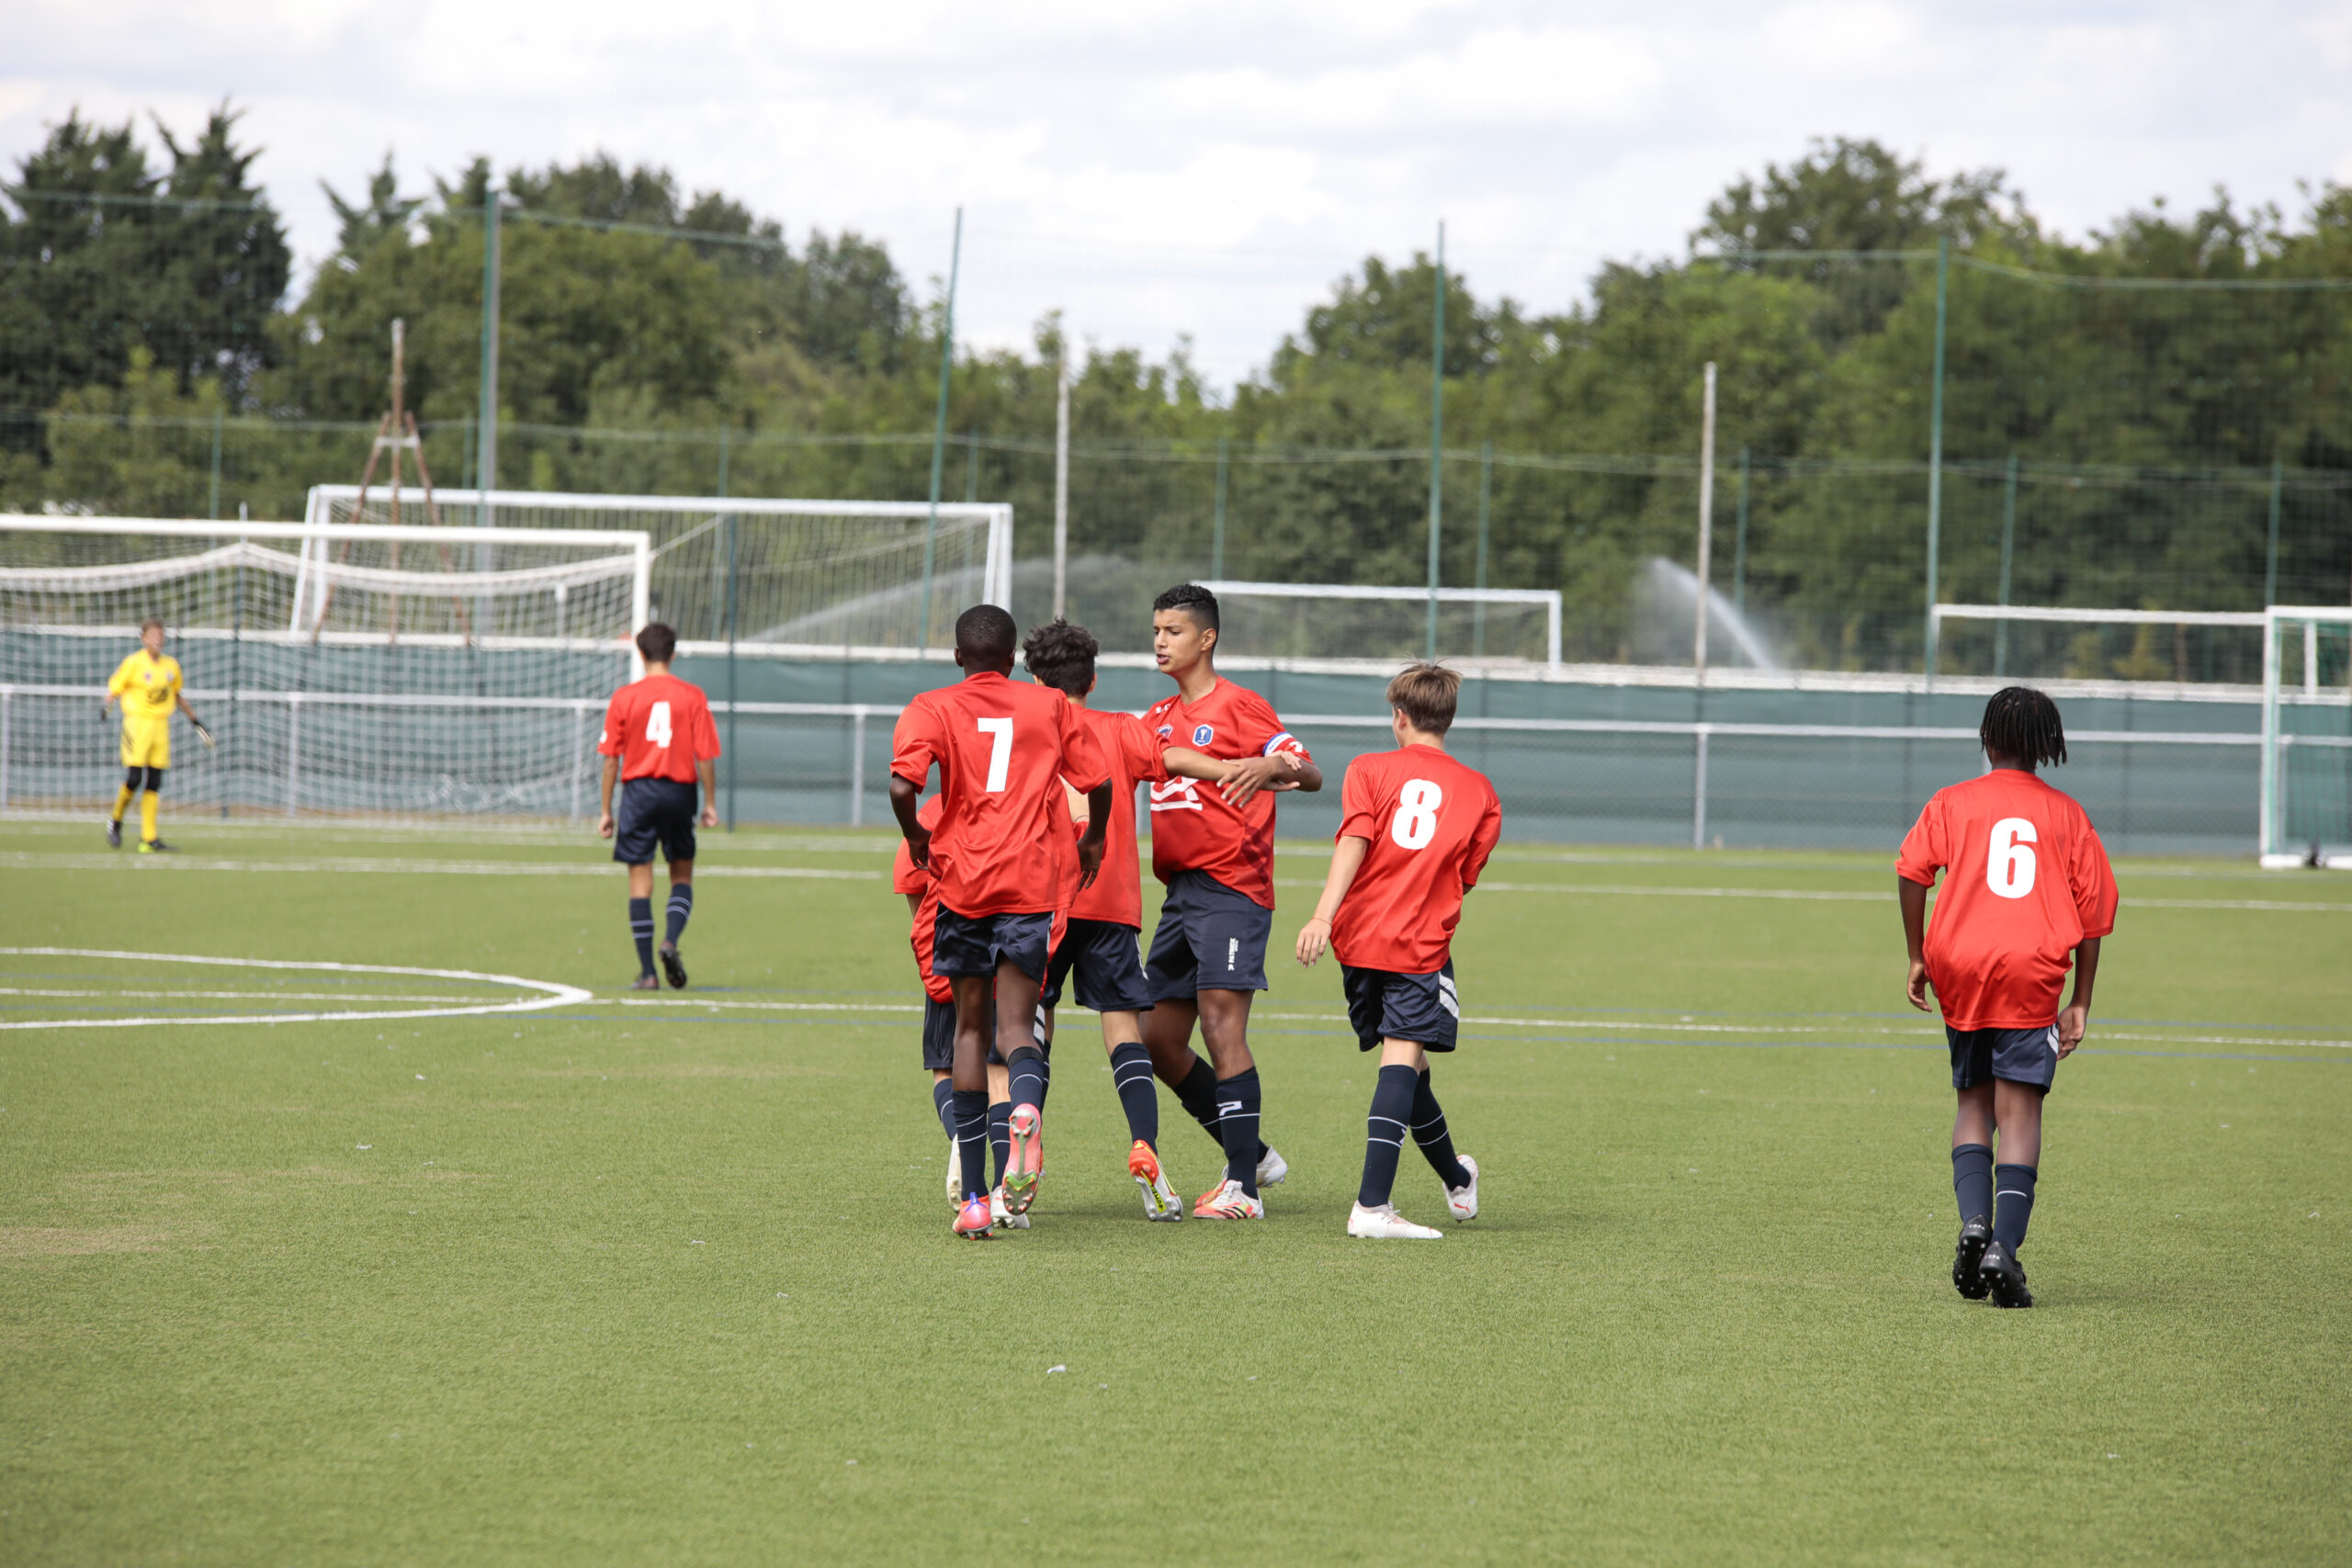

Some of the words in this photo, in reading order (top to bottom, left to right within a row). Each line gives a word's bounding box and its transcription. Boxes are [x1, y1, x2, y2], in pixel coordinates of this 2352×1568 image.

[646, 701, 673, 748] 4
[978, 717, 1013, 792] 7
[1392, 779, 1442, 850] 8
[1987, 818, 2037, 898] 6
